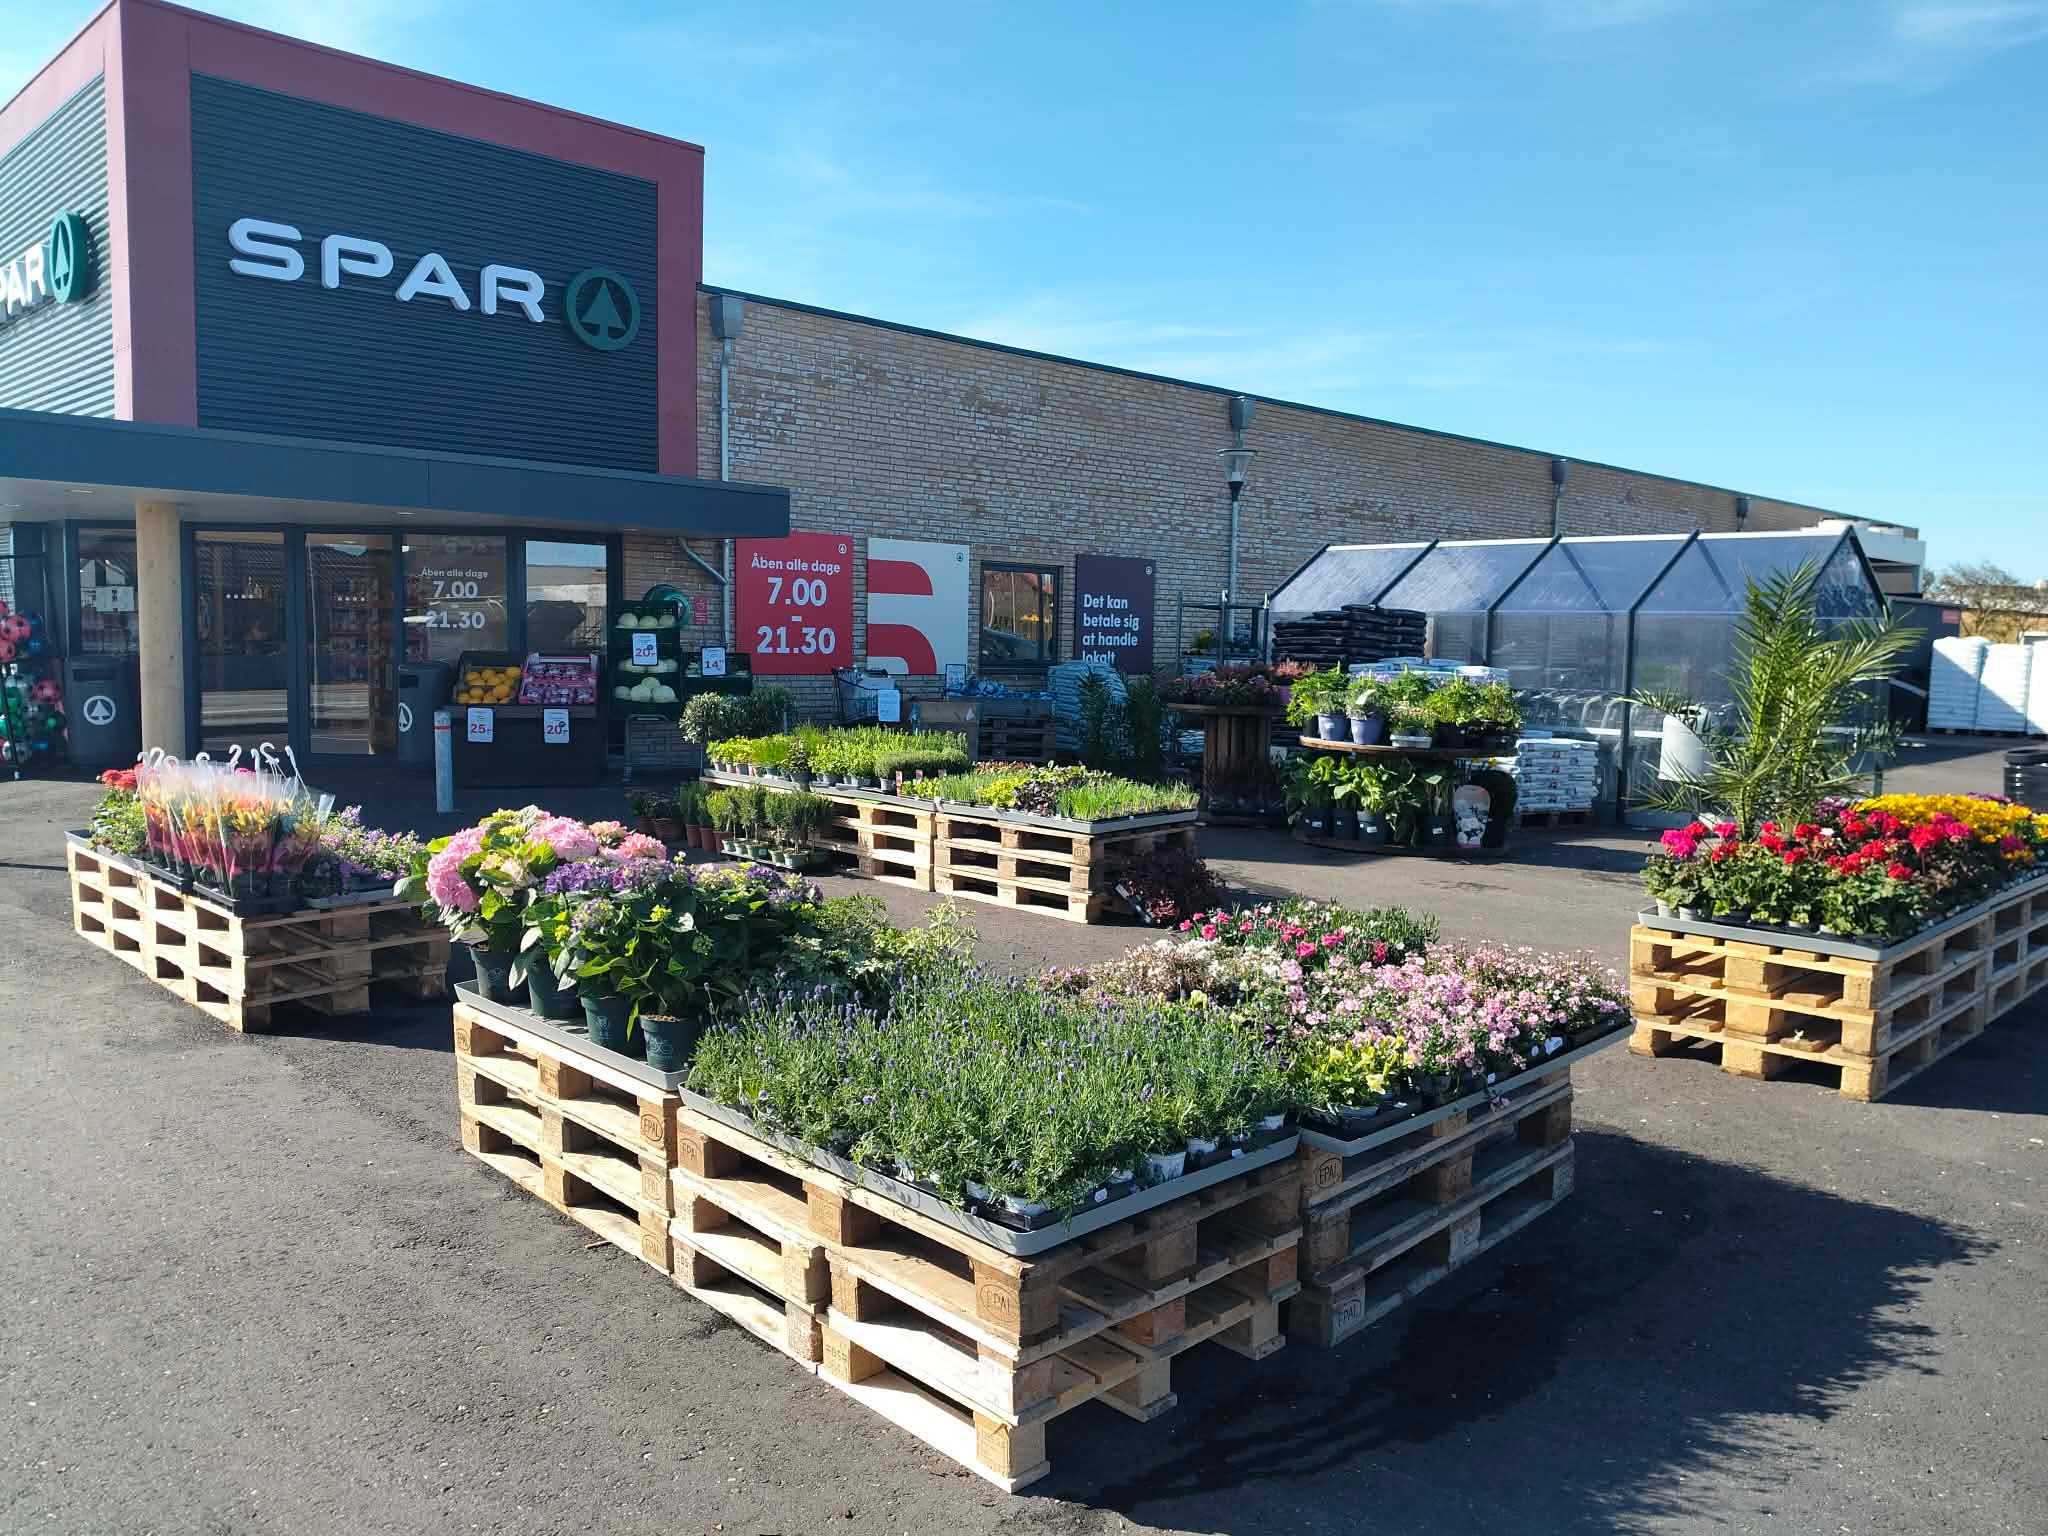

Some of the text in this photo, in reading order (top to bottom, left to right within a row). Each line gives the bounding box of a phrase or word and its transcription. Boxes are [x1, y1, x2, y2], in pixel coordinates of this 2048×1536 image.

[228, 218, 545, 322] SPAR
[751, 552, 840, 576] Åben alle dage
[433, 581, 478, 598] 7.00
[767, 577, 827, 606] 7.00
[1083, 594, 1128, 609] Det kan
[425, 610, 485, 629] 21.30
[1083, 612, 1140, 631] betale sig
[757, 625, 836, 655] 21.30
[1082, 631, 1138, 646] at handle
[643, 1118, 660, 1138] EPAL
